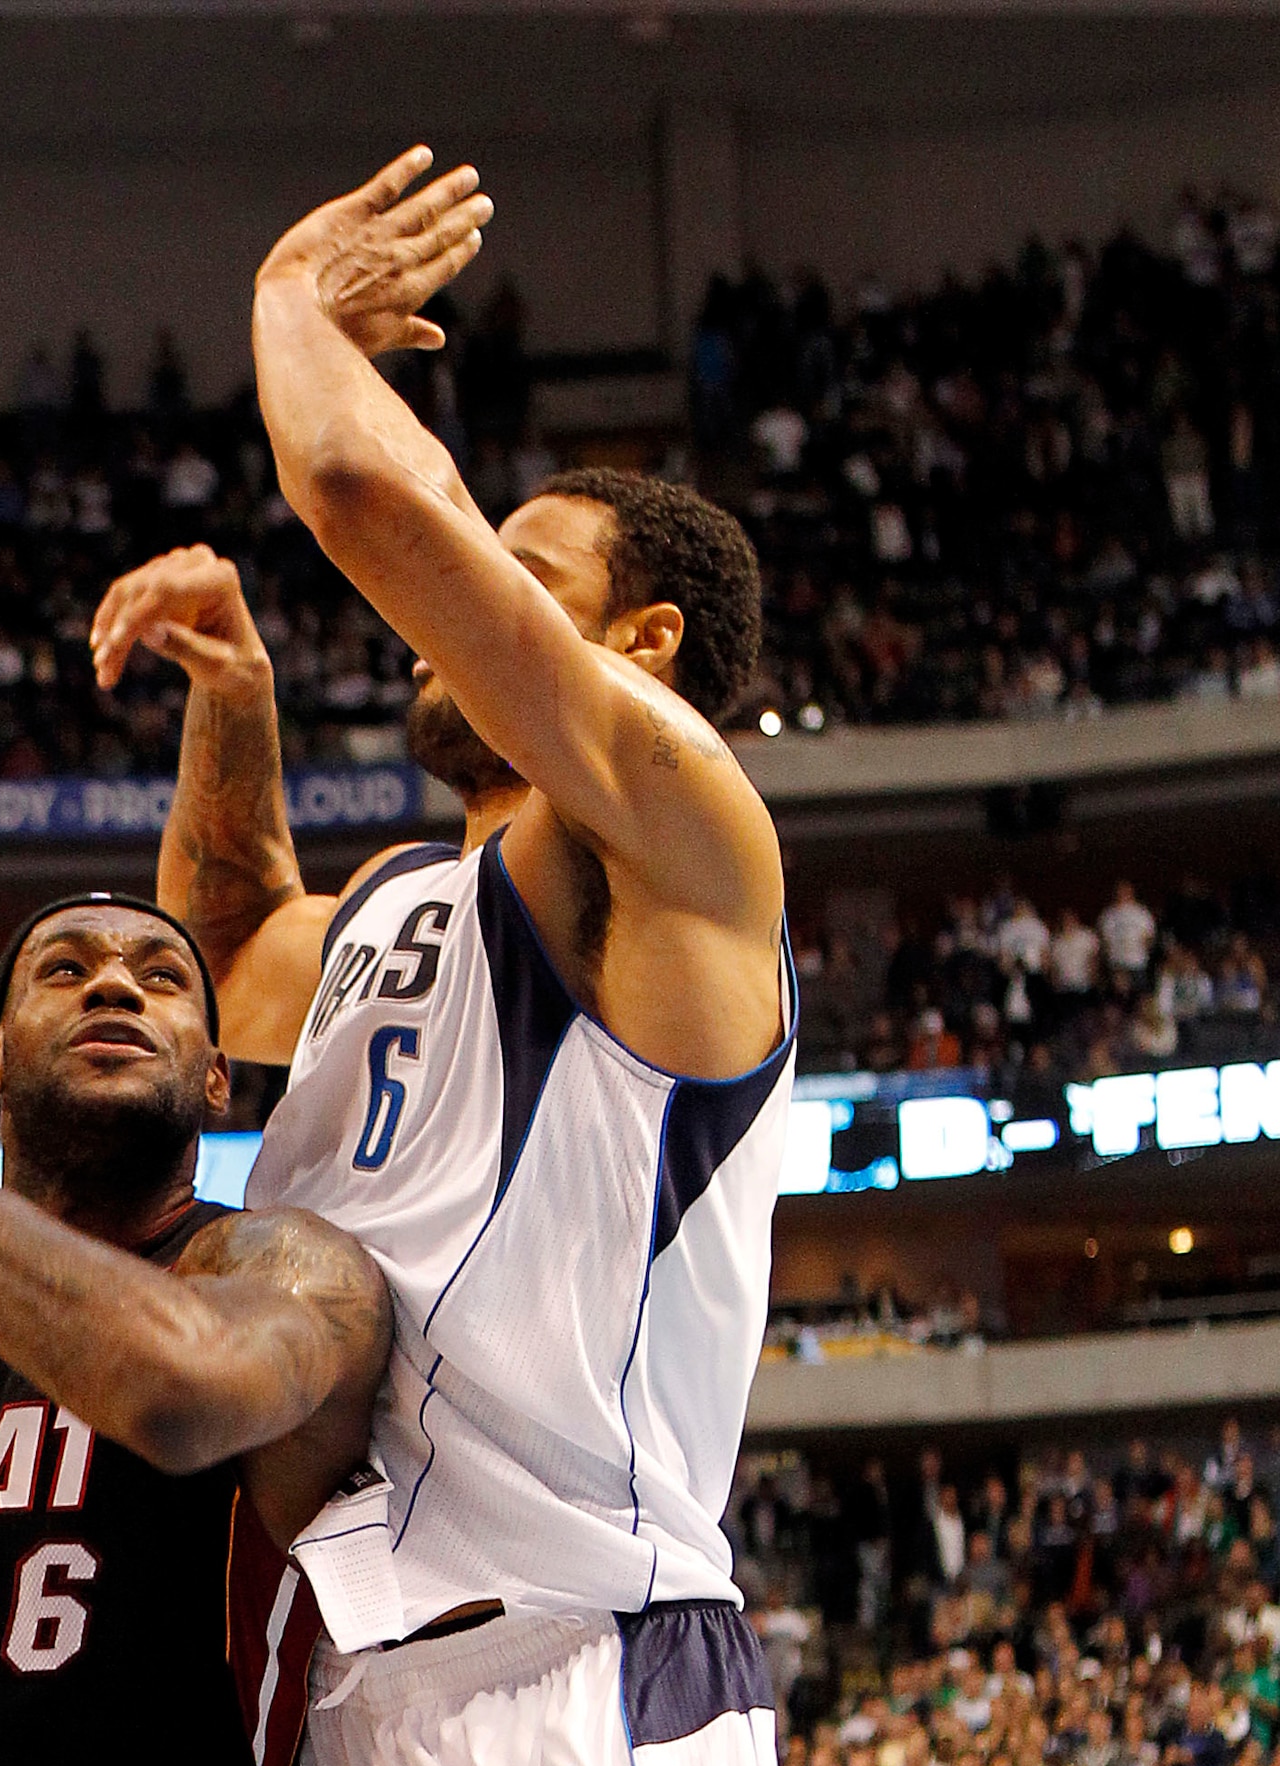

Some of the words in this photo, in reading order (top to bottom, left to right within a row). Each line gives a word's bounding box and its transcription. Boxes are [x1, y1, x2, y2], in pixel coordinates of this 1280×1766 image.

[82, 780, 177, 832] PRO
[352, 1023, 422, 1173] 6
[0, 1540, 102, 1675] 6
